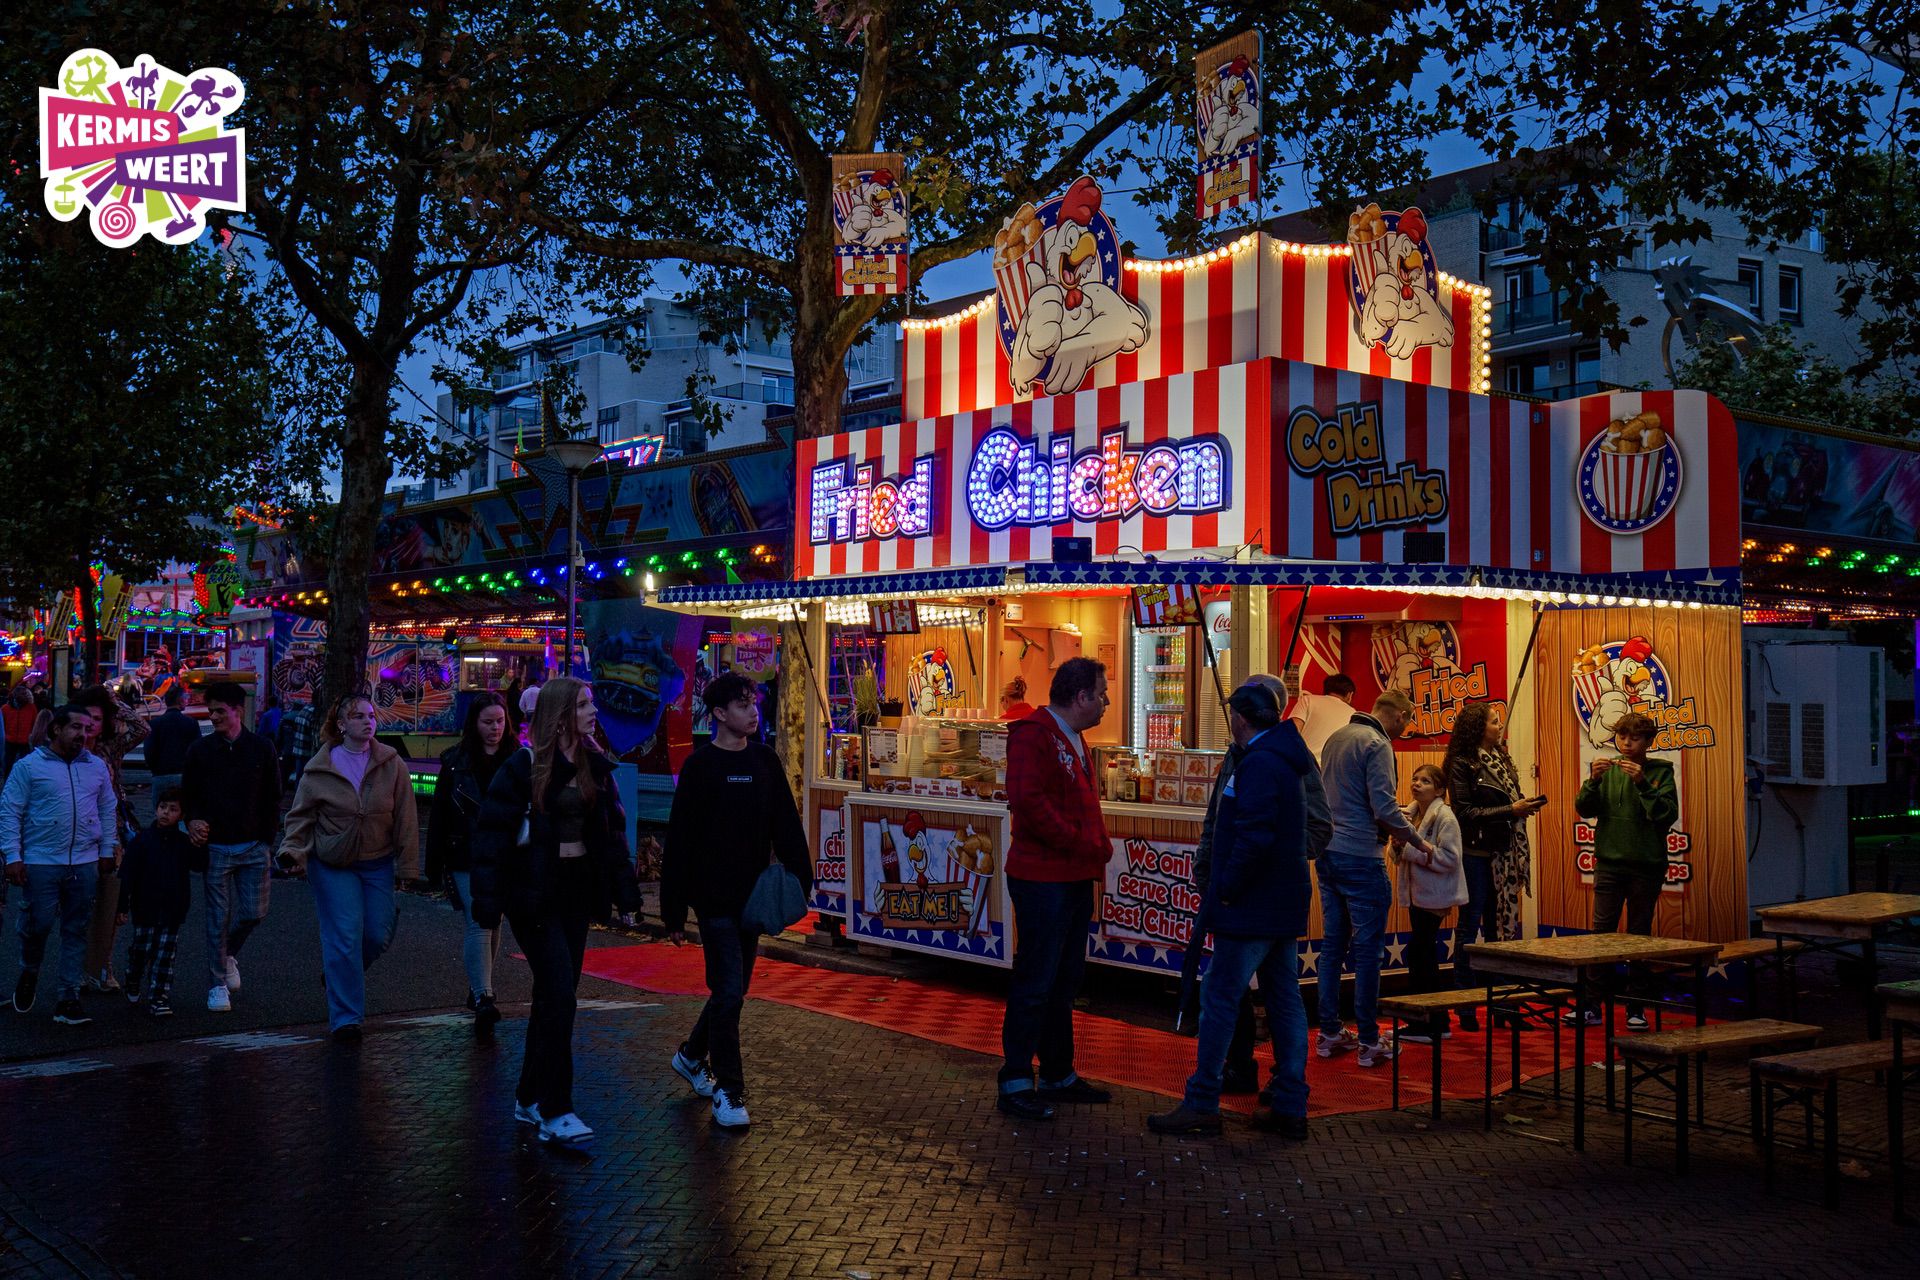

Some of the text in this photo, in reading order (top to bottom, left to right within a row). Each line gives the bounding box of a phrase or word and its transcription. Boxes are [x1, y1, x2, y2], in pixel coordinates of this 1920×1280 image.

[842, 269, 897, 285] Chicken
[1289, 407, 1381, 470] Cold
[811, 428, 1224, 542] Fried Chicken
[1329, 466, 1445, 530] Drinks
[1142, 590, 1169, 606] WINGS
[1412, 665, 1487, 705] Fried
[1126, 840, 1157, 871] We
[890, 892, 920, 918] EAT
[1103, 895, 1141, 929] best
[1120, 875, 1200, 913] serve the
